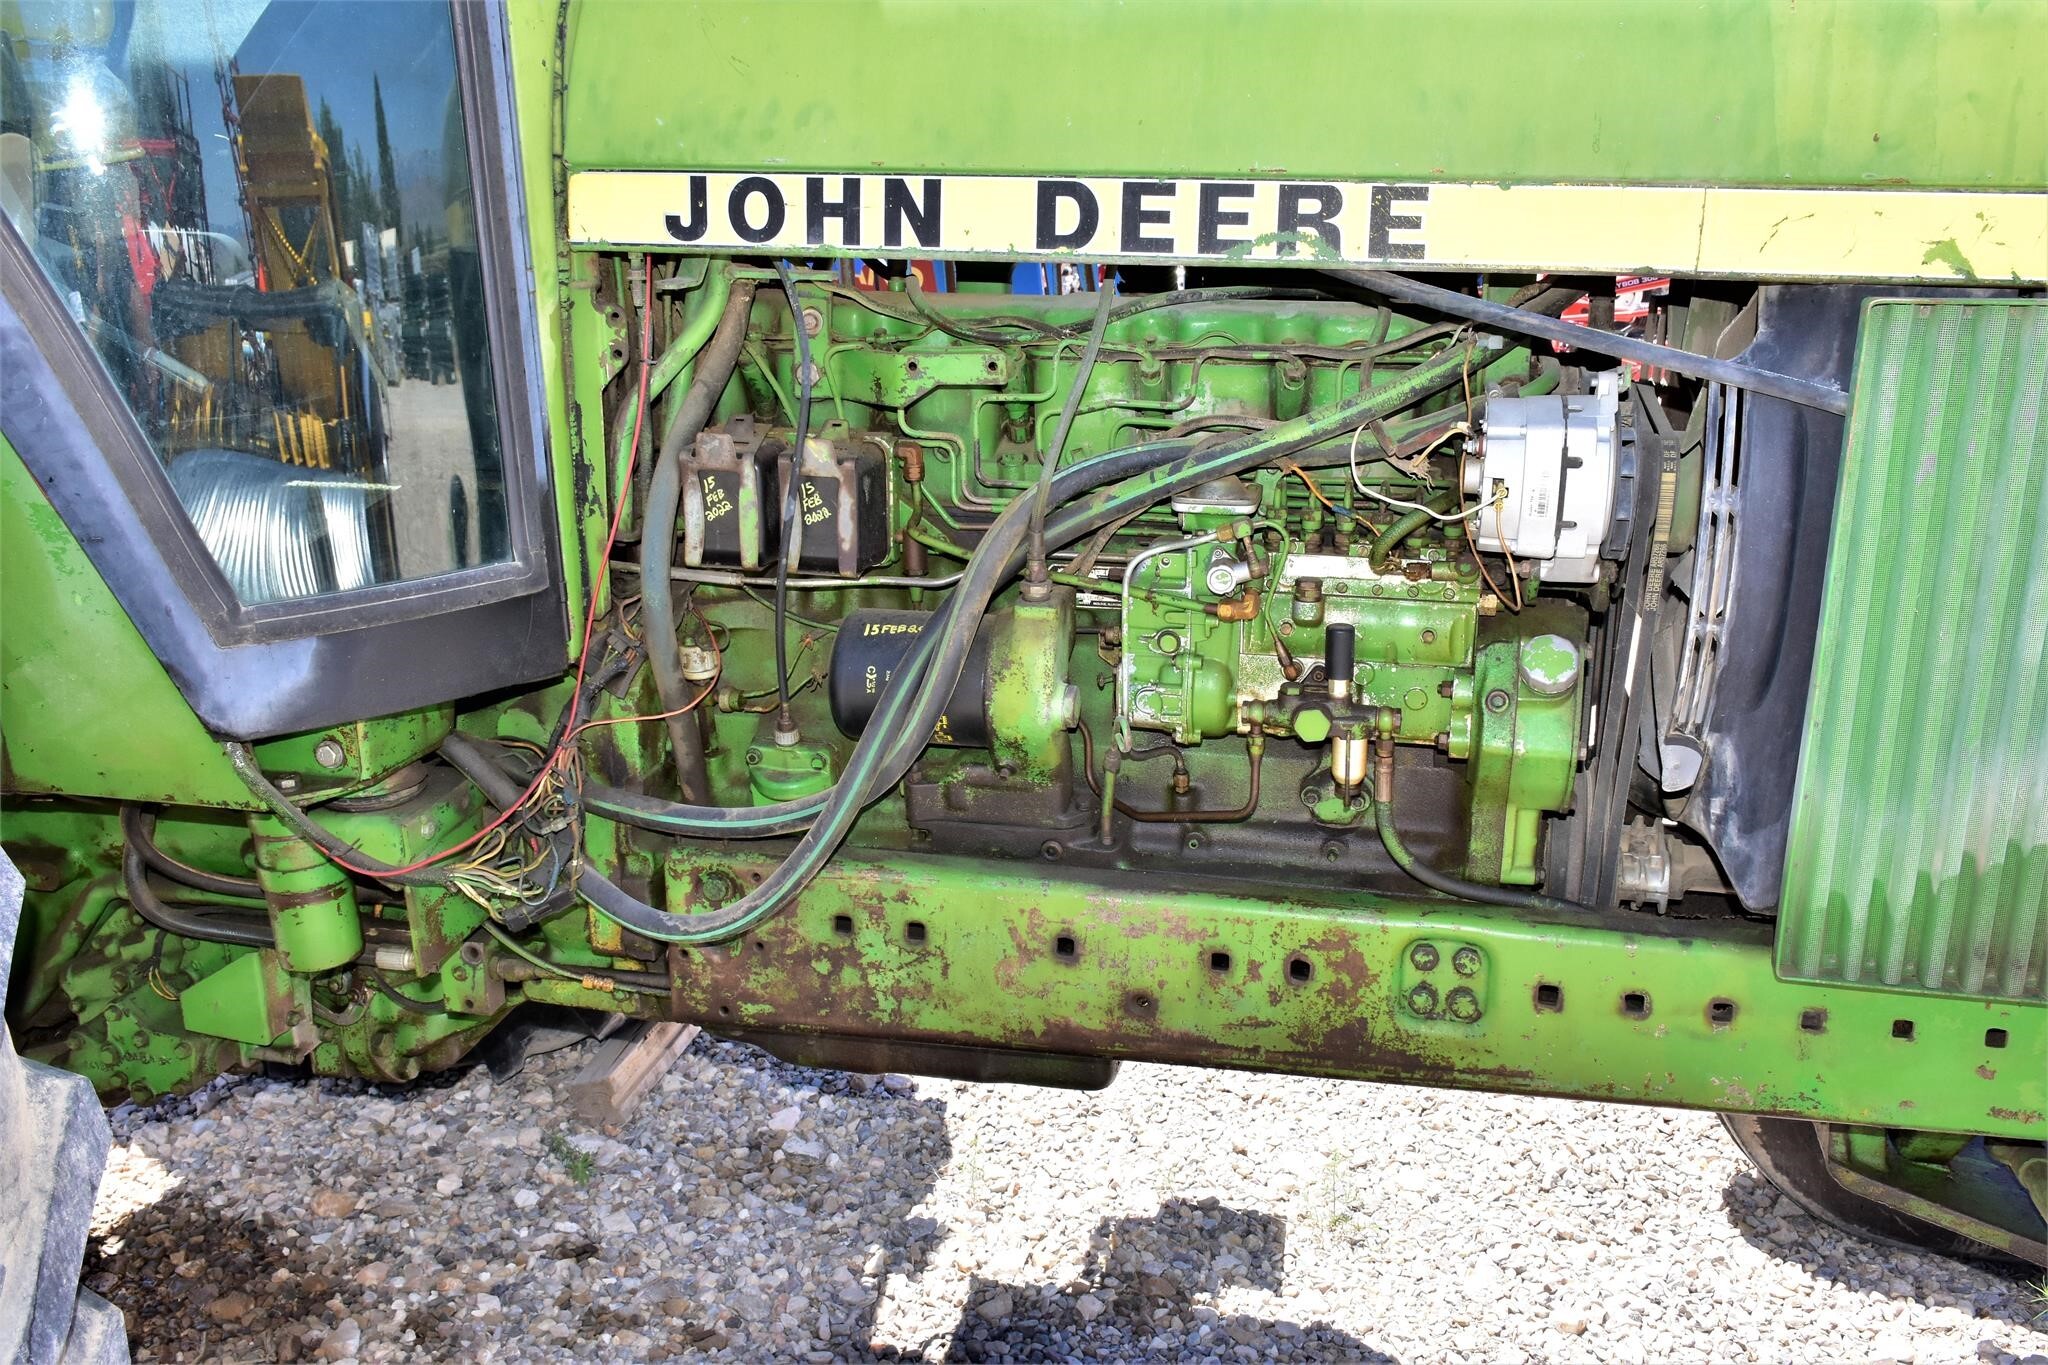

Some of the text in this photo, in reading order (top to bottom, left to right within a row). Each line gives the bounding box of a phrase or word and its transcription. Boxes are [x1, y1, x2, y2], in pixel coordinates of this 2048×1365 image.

[664, 175, 1430, 260] JOHN DEERE
[1616, 278, 1640, 288] YBOB
[703, 475, 715, 493] 15
[801, 481, 815, 499] 15
[706, 488, 725, 507] FEB
[803, 493, 823, 512] FEB
[705, 501, 733, 522] 2022
[804, 507, 832, 525] 2022
